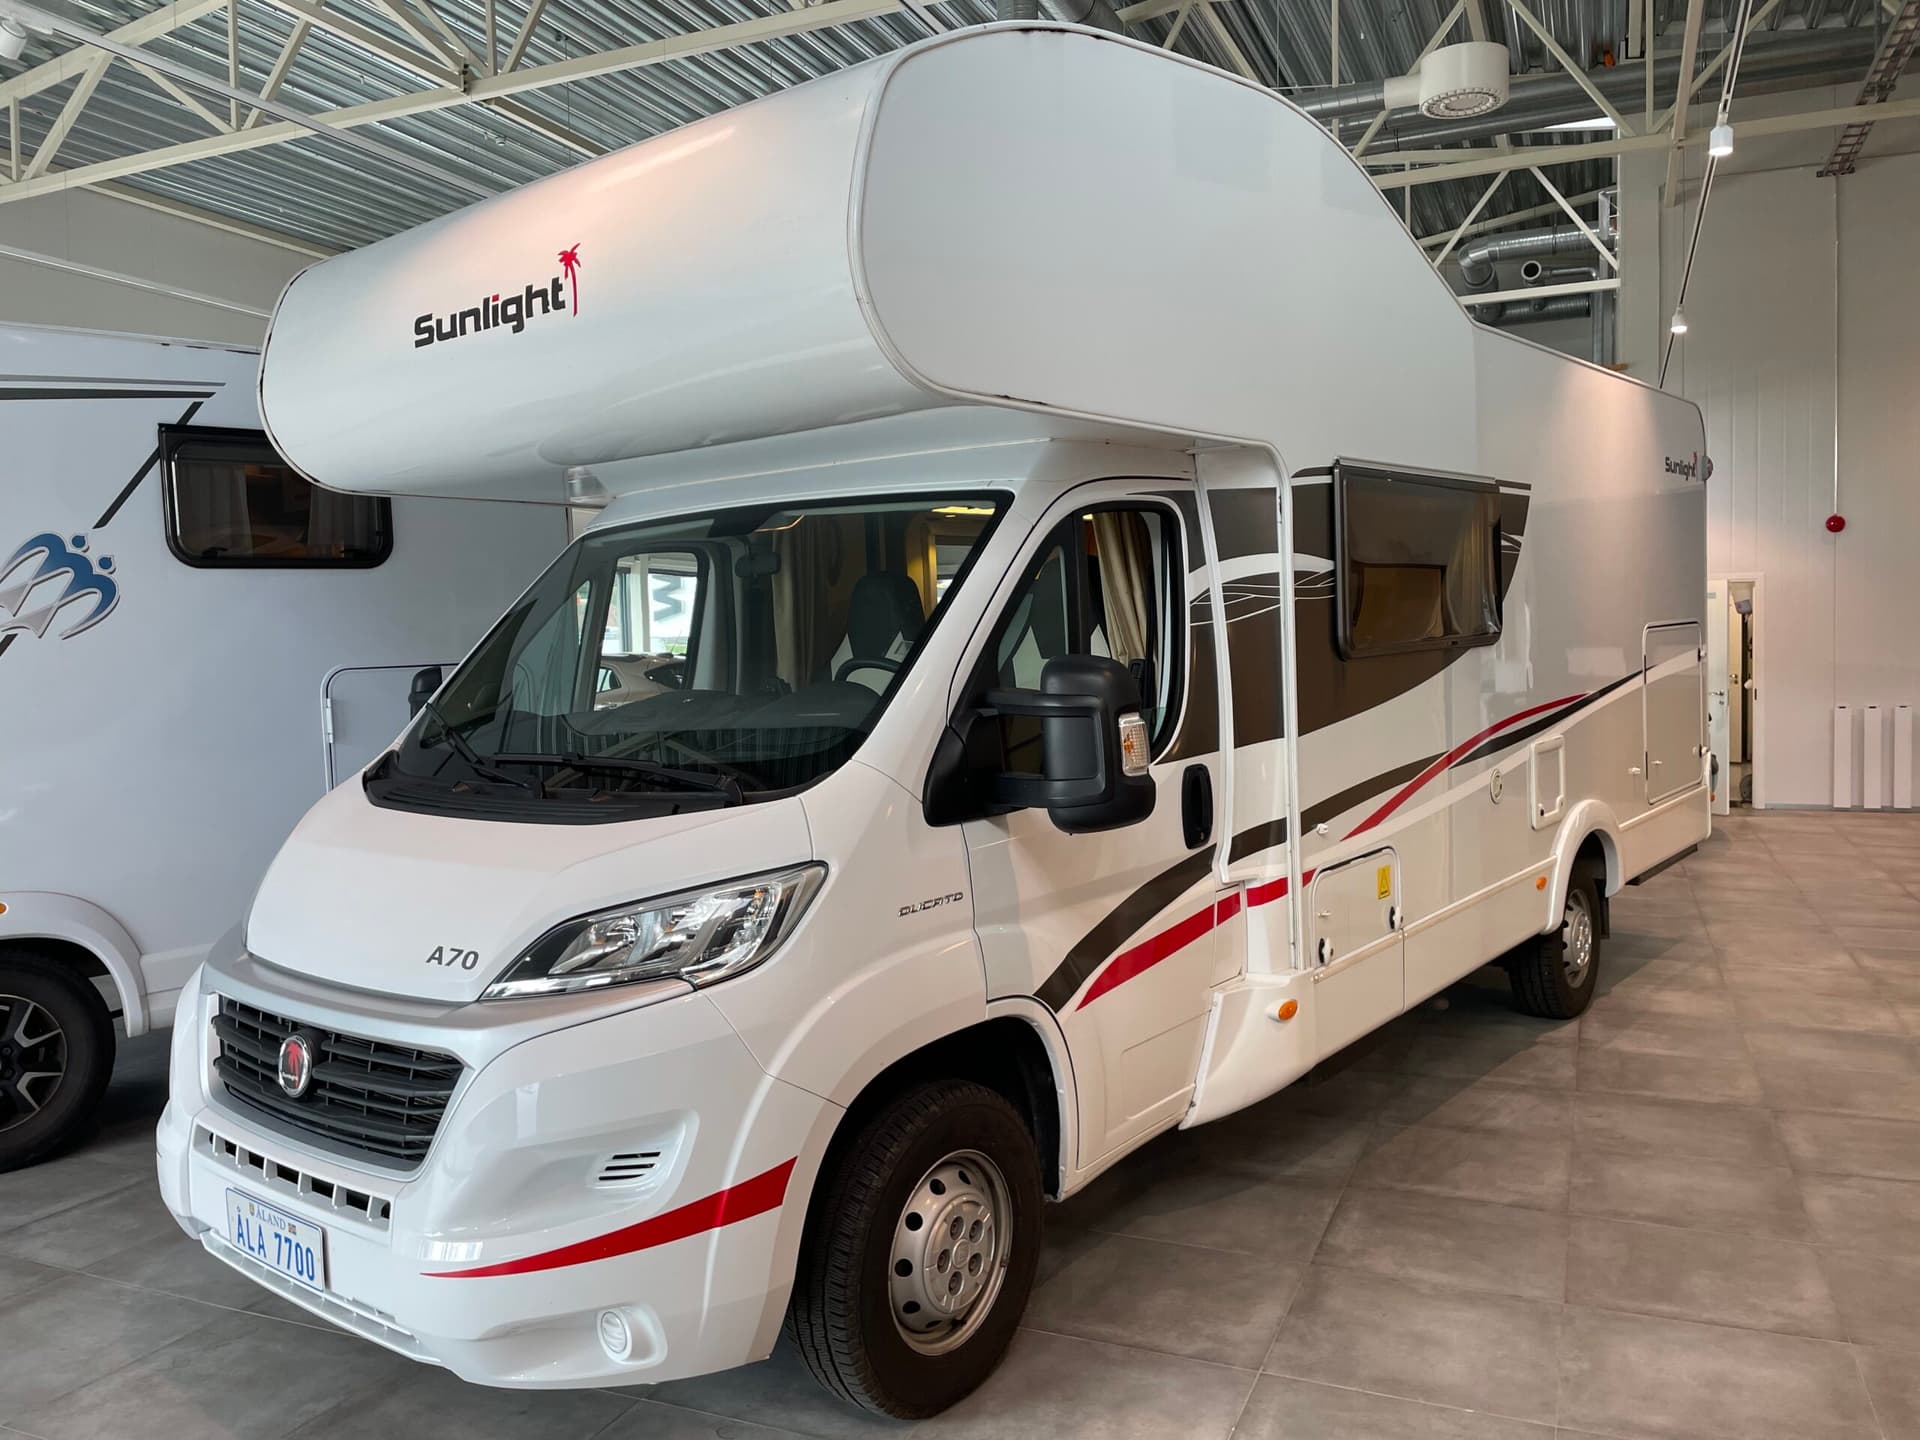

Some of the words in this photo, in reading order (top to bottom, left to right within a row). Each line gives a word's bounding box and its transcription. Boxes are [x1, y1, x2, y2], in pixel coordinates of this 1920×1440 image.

[414, 276, 566, 349] Sunlight
[1665, 456, 1697, 481] Sunlight
[898, 891, 964, 918] DUCATO
[425, 945, 479, 970] A70
[273, 1231, 316, 1281] 7700
